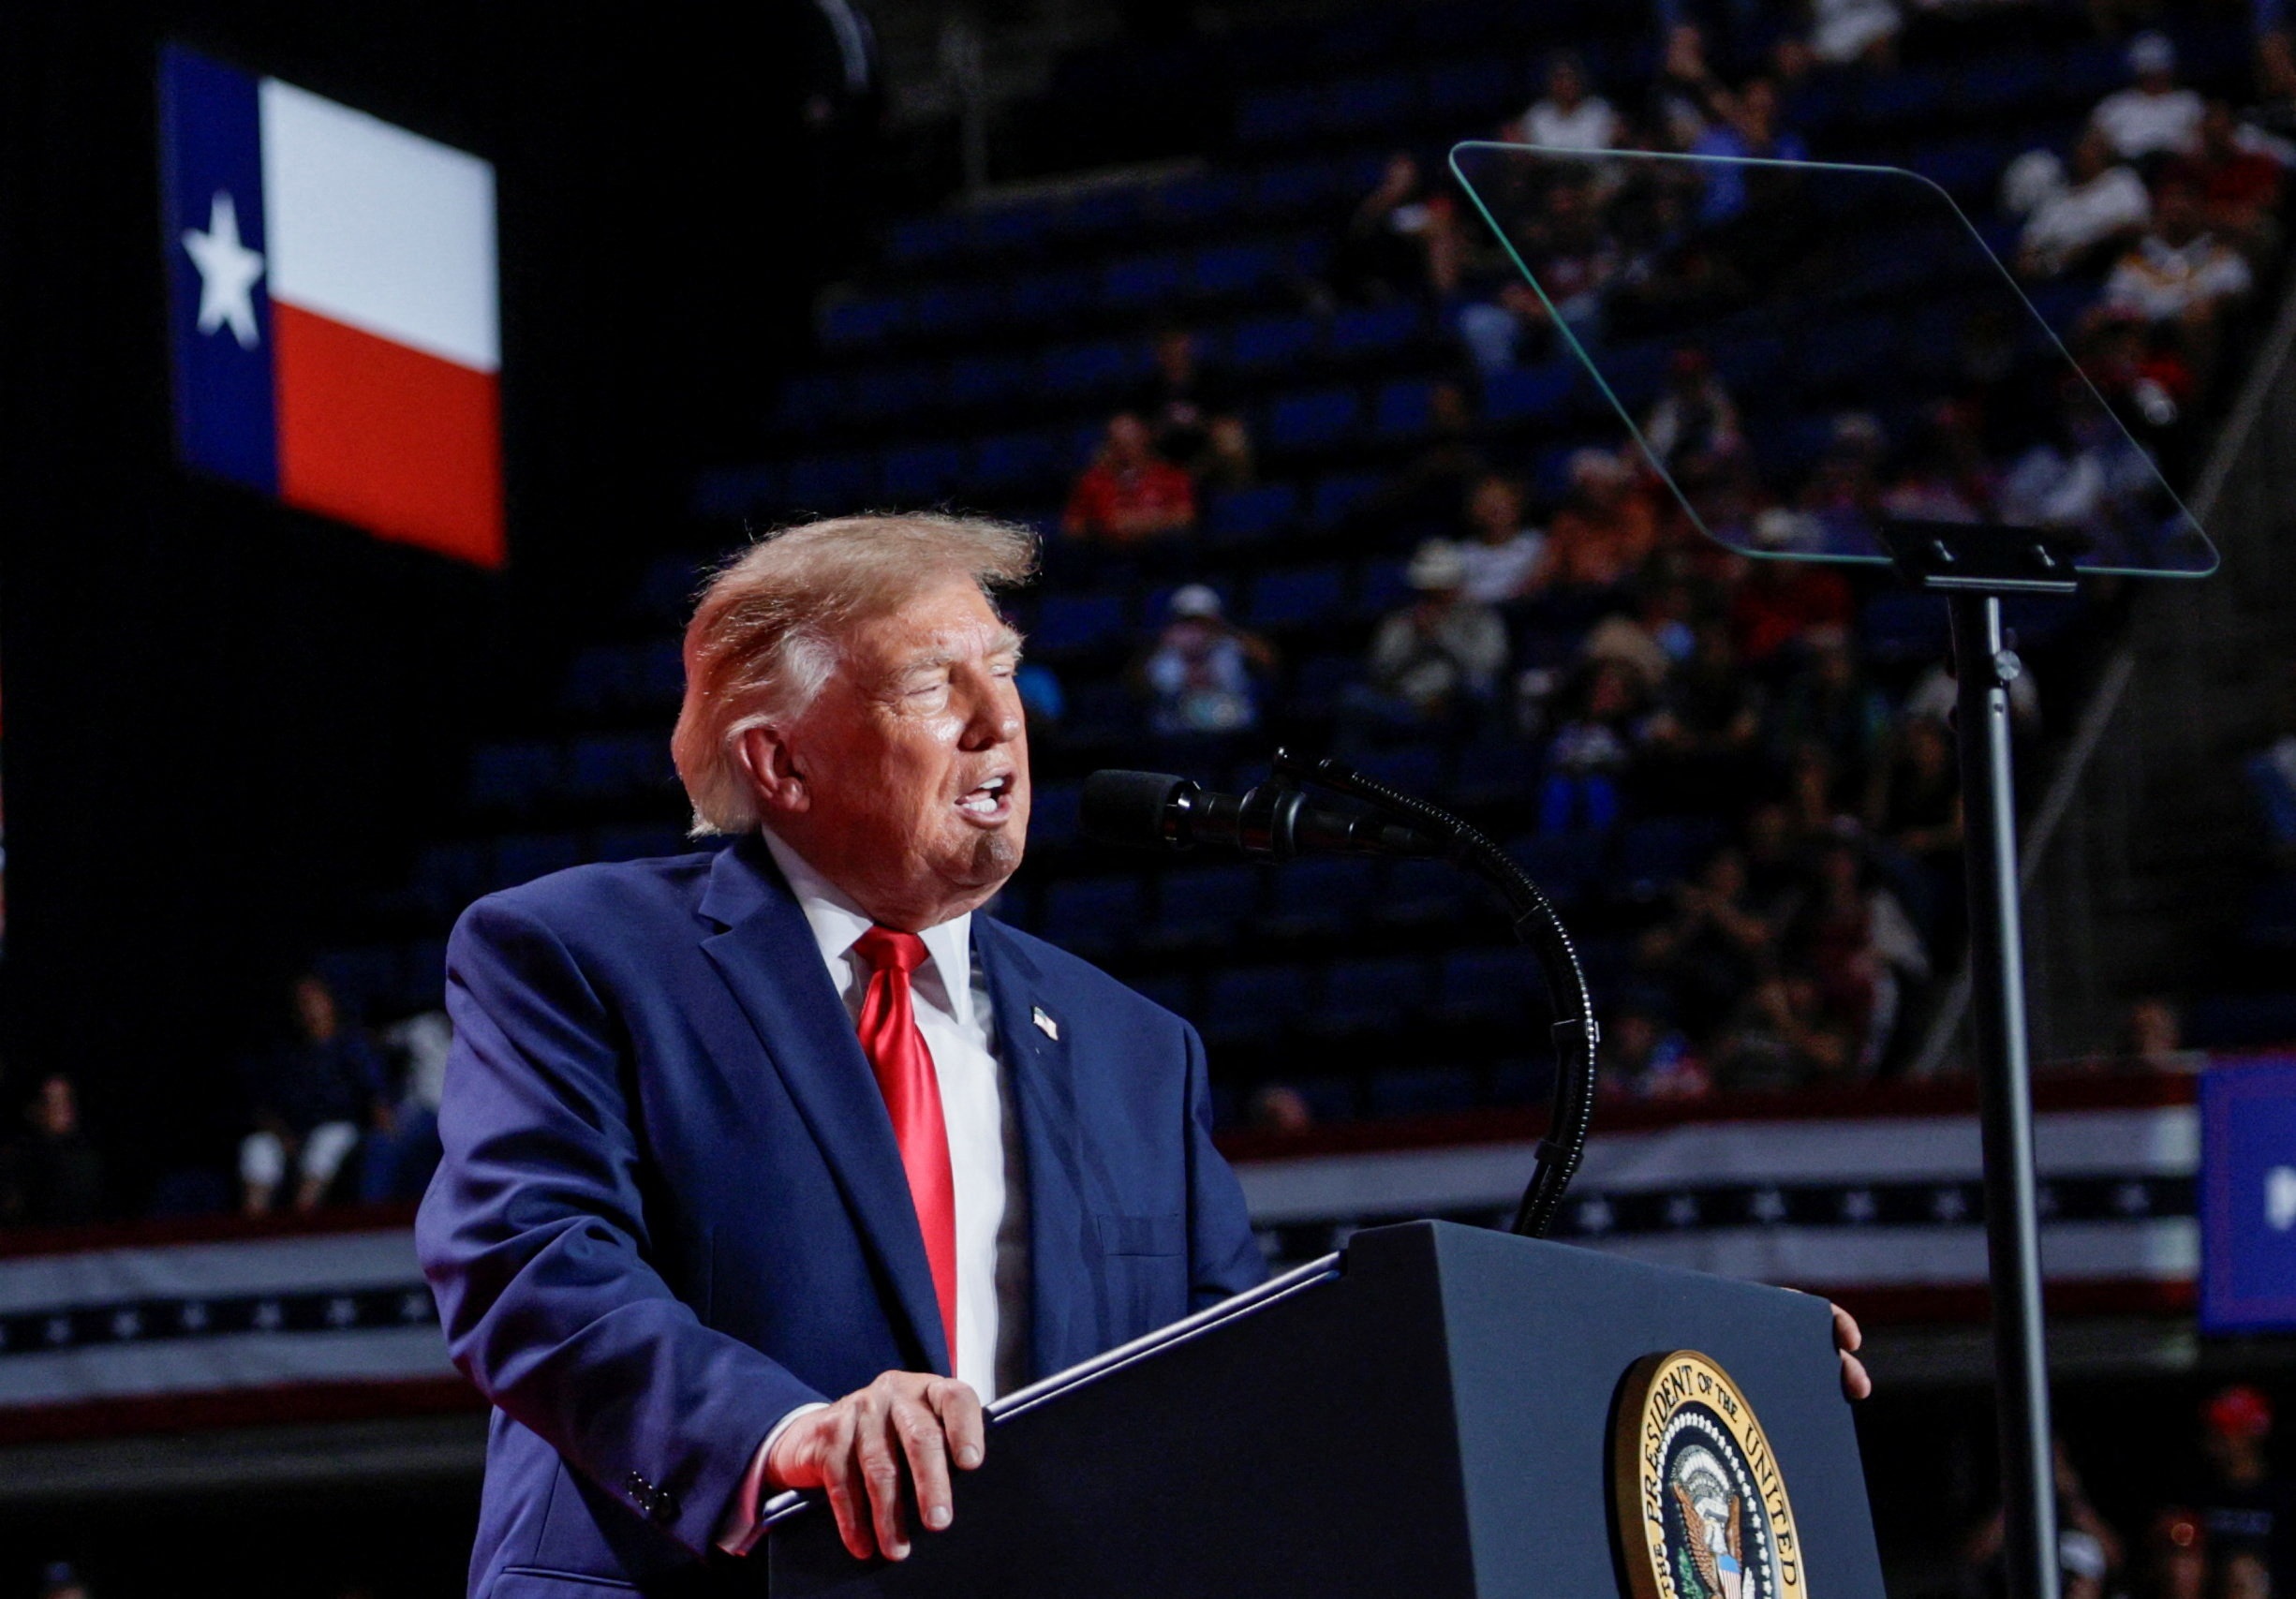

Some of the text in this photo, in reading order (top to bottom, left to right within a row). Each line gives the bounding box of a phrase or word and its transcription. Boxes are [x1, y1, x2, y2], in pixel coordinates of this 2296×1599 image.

[1643, 1365, 1693, 1523] PRESIDENT
[1696, 1370, 1713, 1396] OF
[1714, 1383, 1739, 1424] THE
[1744, 1426, 1798, 1586] UNITED
